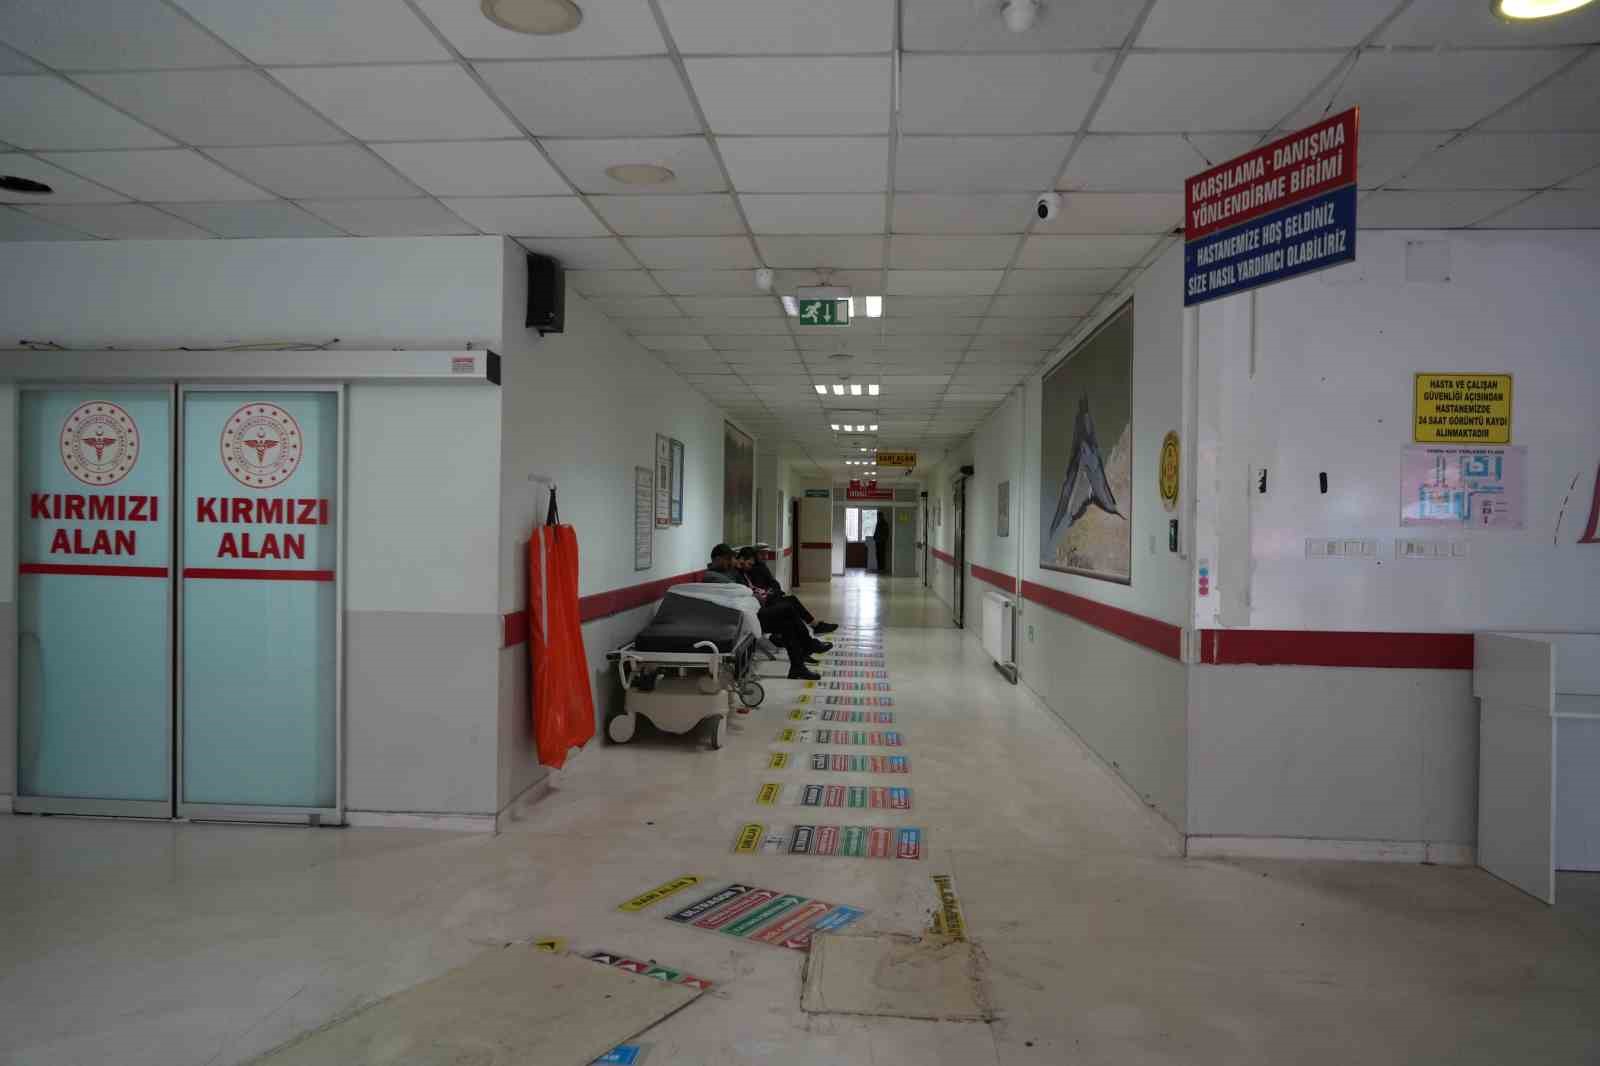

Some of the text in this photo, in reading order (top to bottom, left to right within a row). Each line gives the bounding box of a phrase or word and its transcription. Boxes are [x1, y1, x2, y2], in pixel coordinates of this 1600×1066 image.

[1192, 156, 1264, 203] KARŞILAMA
[1273, 122, 1345, 171] DANIŞMA
[1192, 149, 1343, 229] YÖNLENDİRME BİRİMİ
[1197, 202, 1335, 266] HASTANEMİZE HOŞ GELDİNİZ
[1188, 229, 1346, 296] SİZE NASIL YARDIMCI OLABİLİRİZ
[1430, 380, 1498, 390] HASTA VE ÇALIŞAN
[1464, 392, 1504, 402] AÇISINDAN
[1428, 416, 1447, 424] SAAT
[1449, 415, 1484, 425] GÖRÜNTÜ
[1486, 416, 1507, 426] KAYDI
[1436, 428, 1489, 438] ALINMAKTADIR
[31, 492, 158, 521] KIRMIZI
[196, 496, 329, 526] KIRMIZI
[49, 528, 136, 556] ALAN
[217, 532, 305, 560] ALAN
